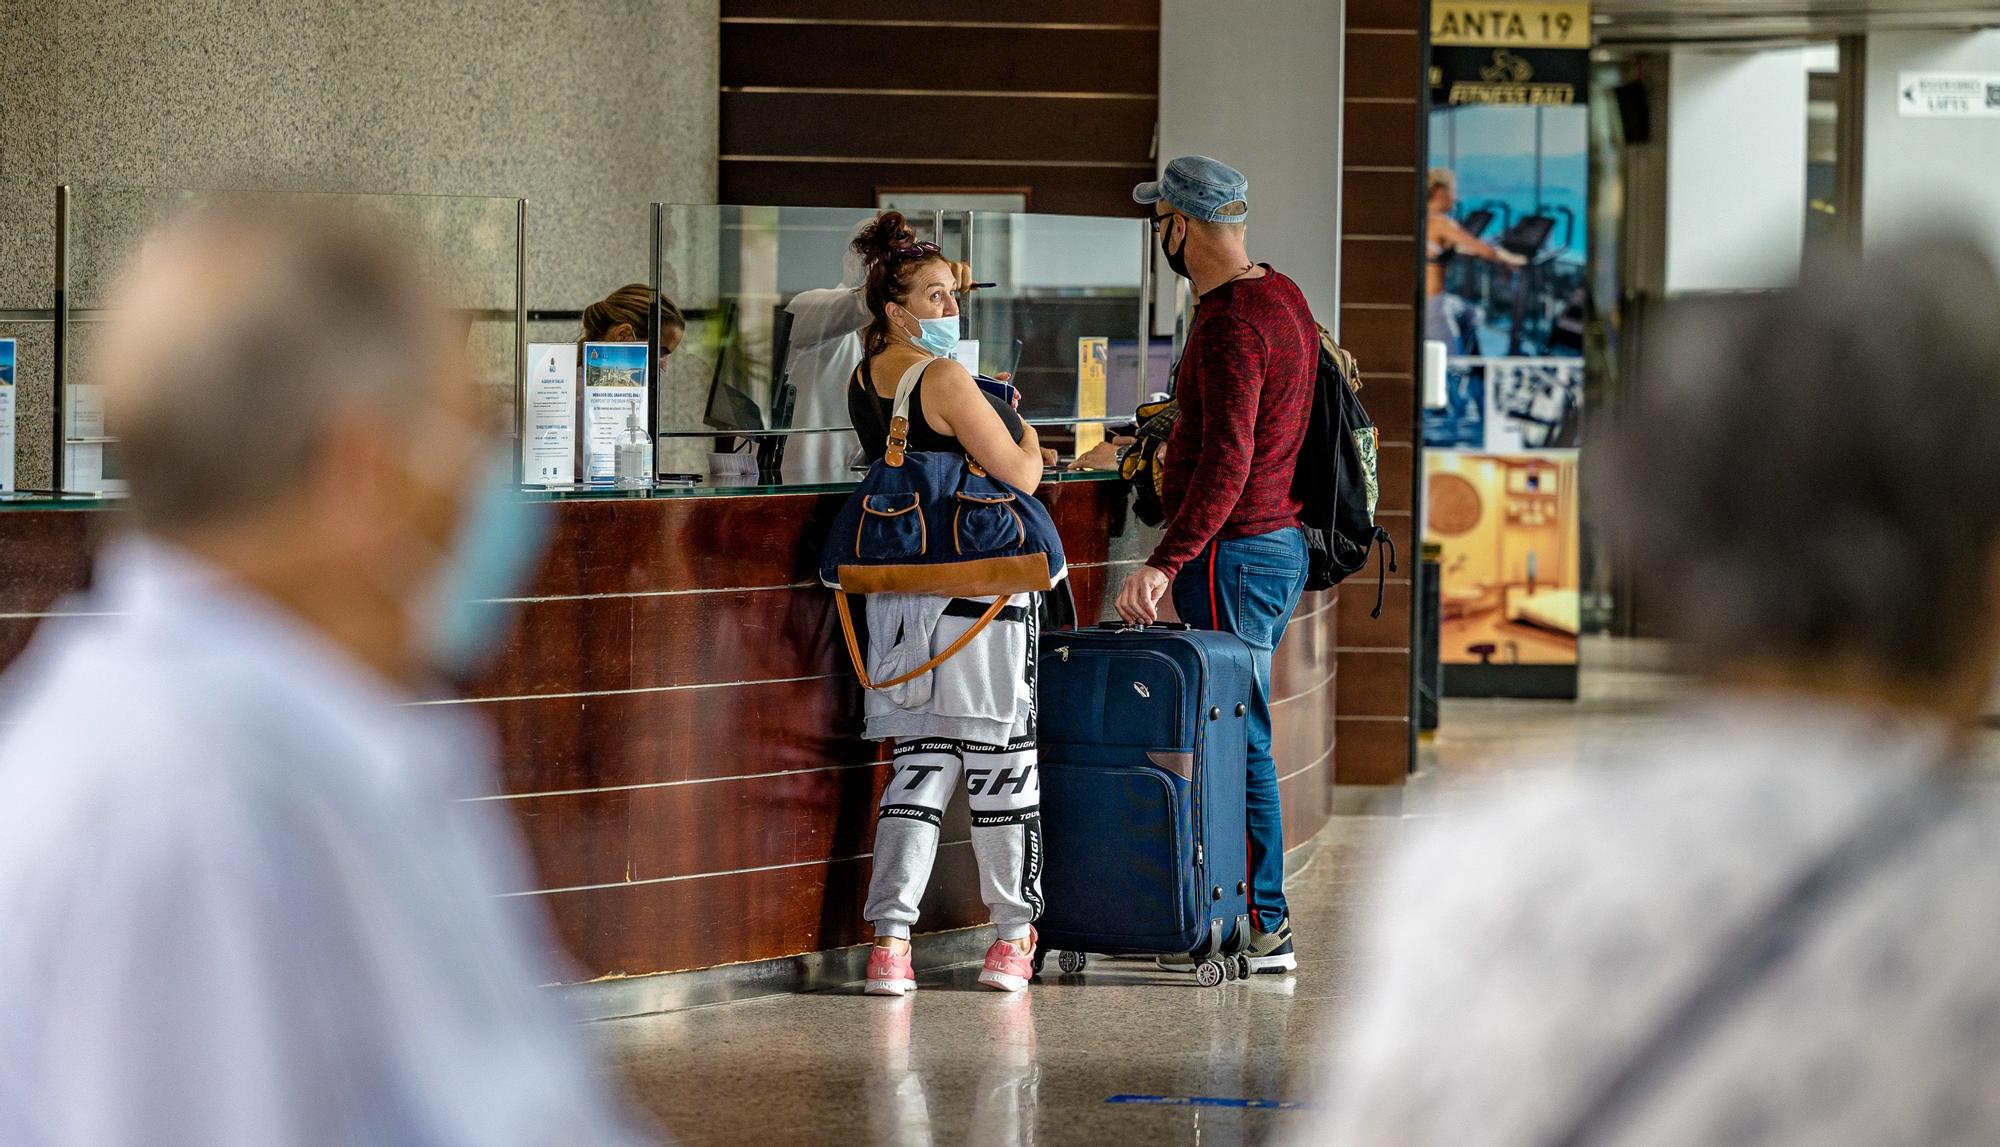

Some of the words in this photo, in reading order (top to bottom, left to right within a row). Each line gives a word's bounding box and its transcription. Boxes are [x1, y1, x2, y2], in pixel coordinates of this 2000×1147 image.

[1431, 10, 1527, 39] ANTA
[1538, 11, 1573, 41] 19
[920, 742, 953, 750] TOUGH
[966, 743, 996, 752] TOUGH
[1003, 740, 1035, 752] TOUGH
[887, 808, 924, 817] TOUGH
[977, 815, 1013, 824] TOUGH
[1028, 830, 1039, 880] TOUGH
